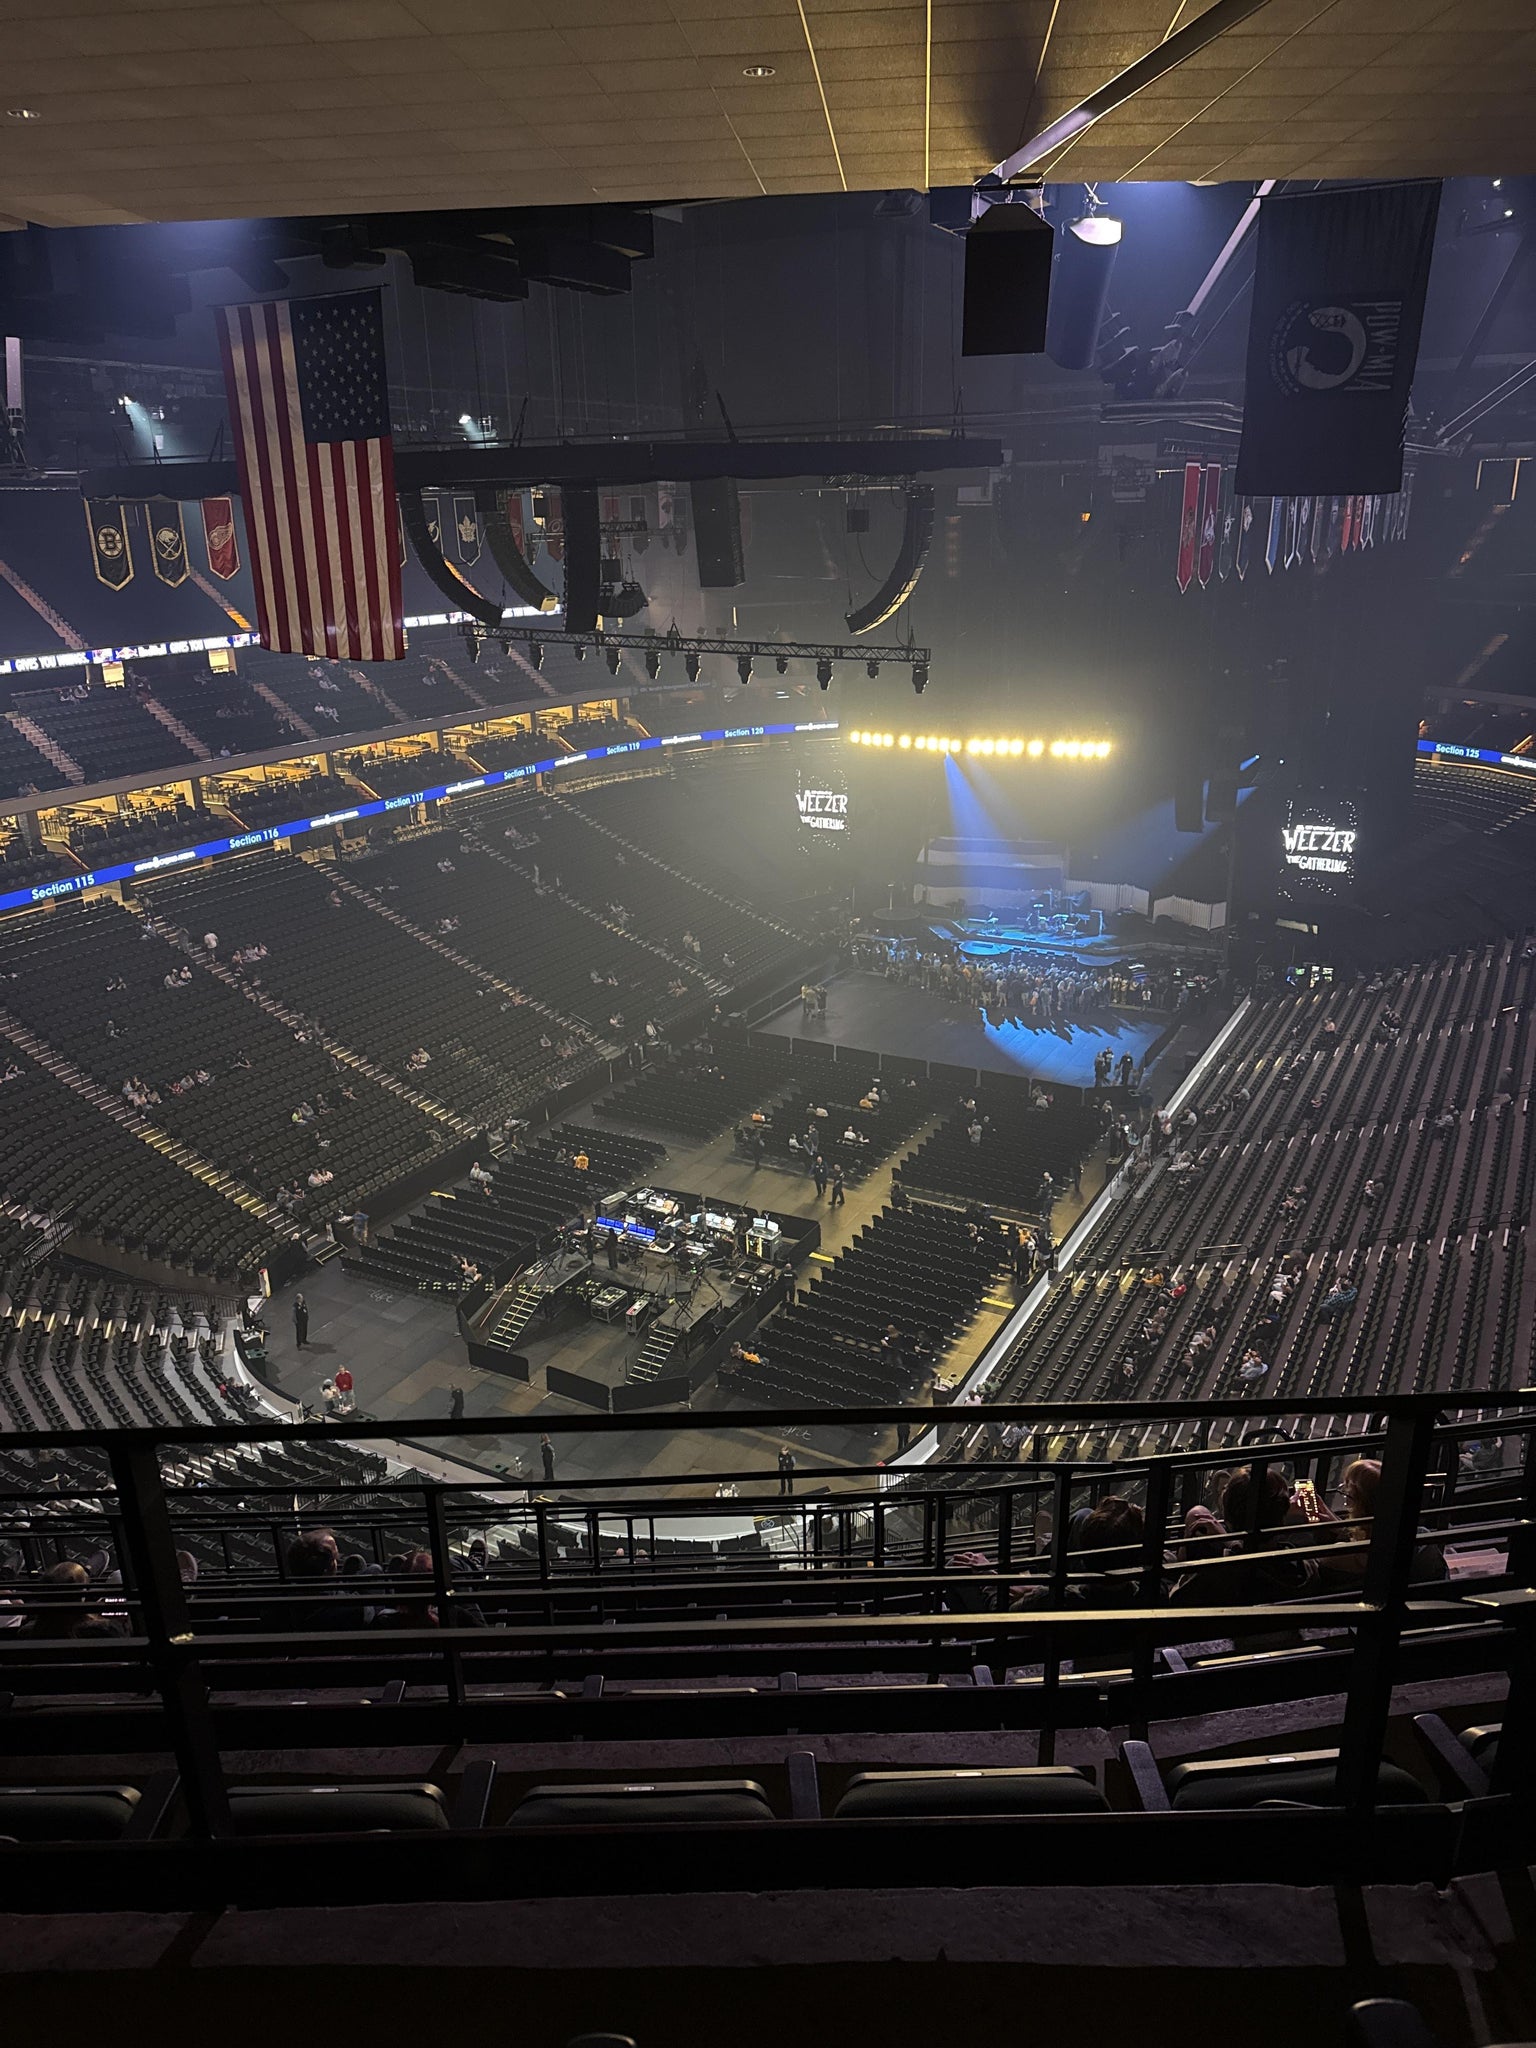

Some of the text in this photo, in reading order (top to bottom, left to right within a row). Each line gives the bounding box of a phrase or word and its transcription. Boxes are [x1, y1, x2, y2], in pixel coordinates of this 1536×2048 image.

[1344, 301, 1402, 391] POW MIA
[724, 727, 764, 738] Section 120
[606, 741, 641, 755] Section 119
[1436, 743, 1480, 759] Section 125
[503, 768, 525, 780] Section
[385, 792, 424, 810] Section 117
[796, 793, 848, 813] WEEZER
[229, 828, 279, 849] Section 116
[1282, 829, 1356, 854] WEEZER
[1299, 856, 1348, 873] GATHERING
[31, 874, 95, 901] Section 115
